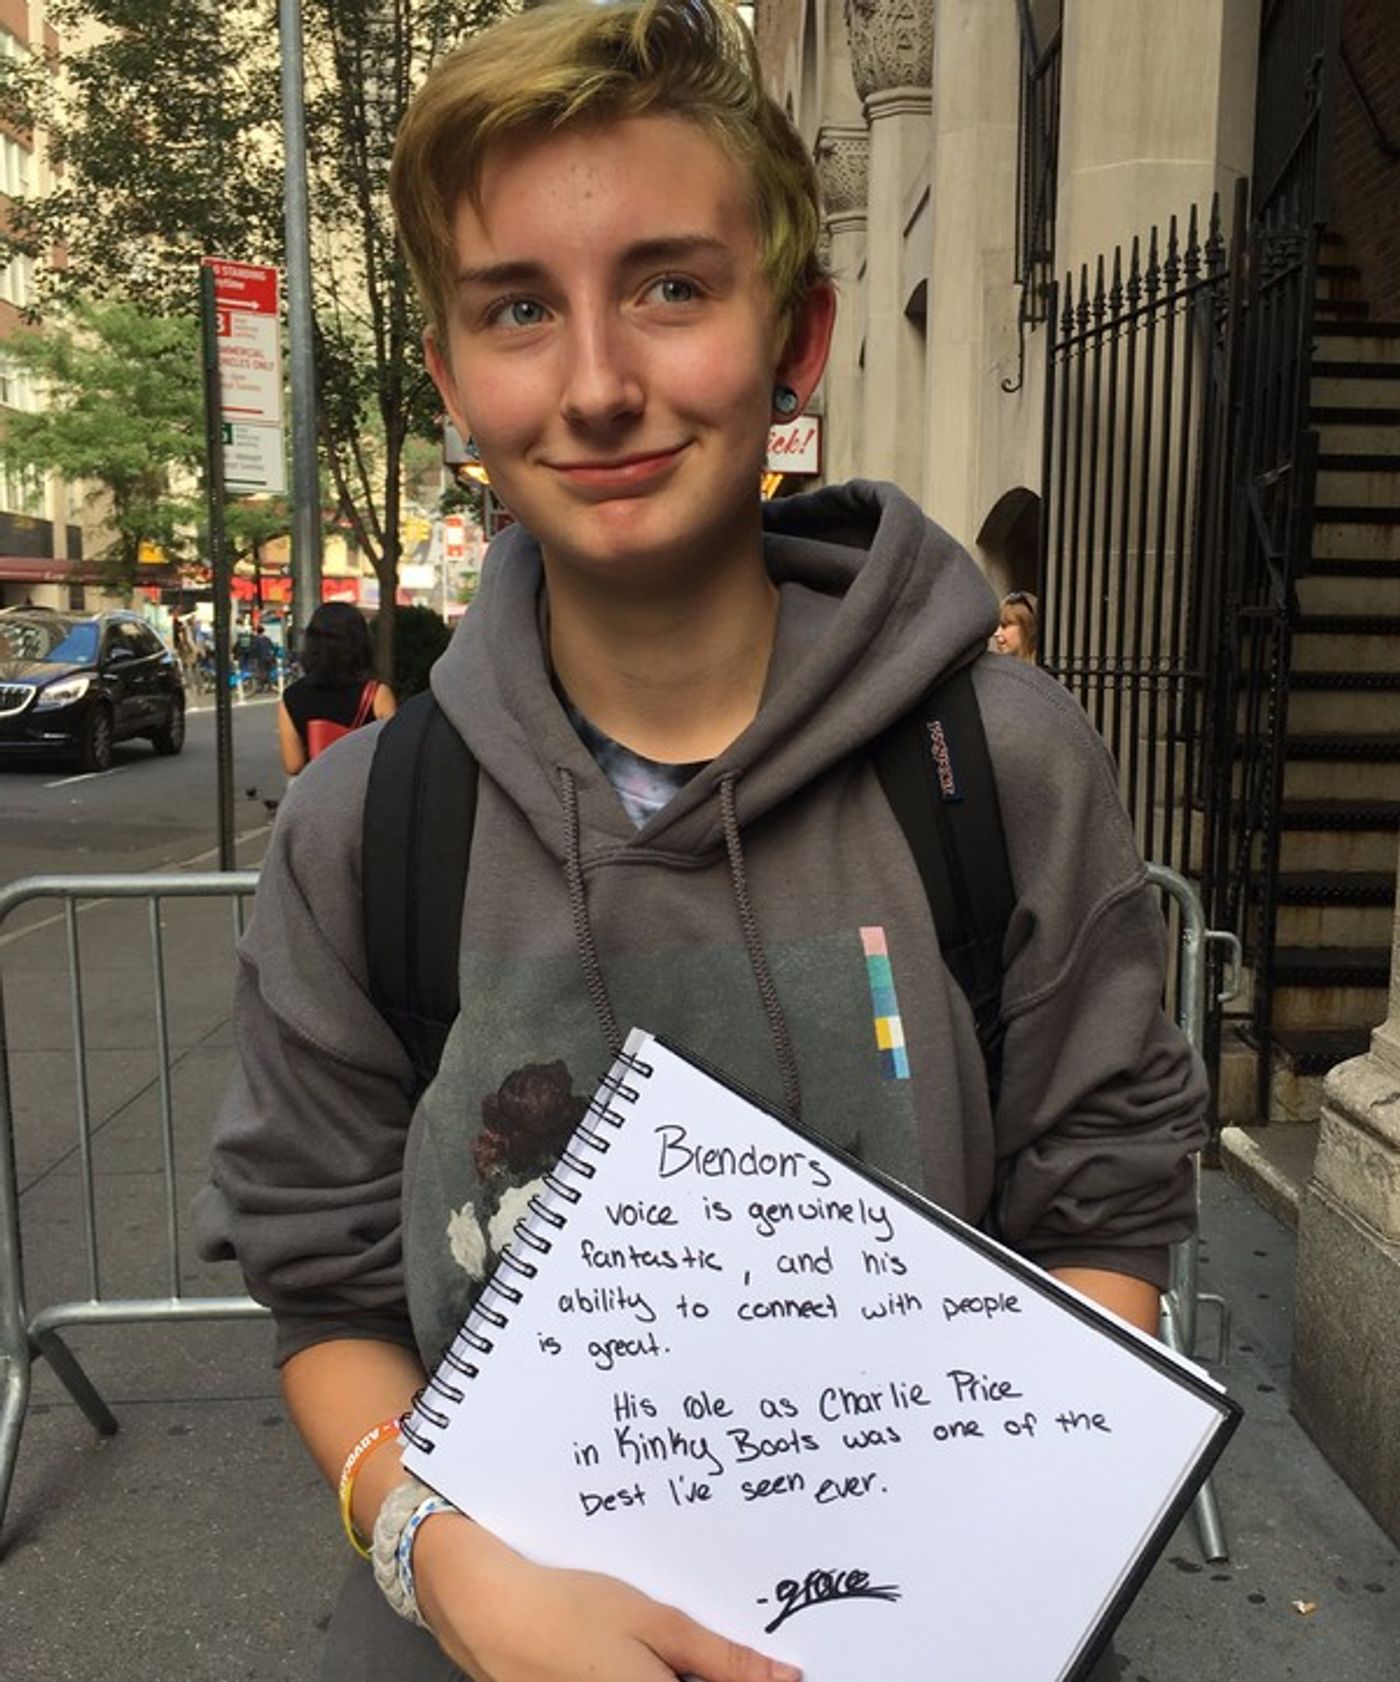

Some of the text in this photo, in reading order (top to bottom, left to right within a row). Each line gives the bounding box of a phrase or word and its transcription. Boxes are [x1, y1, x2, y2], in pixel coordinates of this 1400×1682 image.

[605, 1193, 899, 1243] voice is genuinely
[776, 1245, 834, 1276] and
[861, 1250, 908, 1276] his
[557, 1285, 1023, 1324] ability to connect with people
[536, 1331, 671, 1372] is great.
[613, 1369, 1024, 1423] His role as Charlie Price
[573, 1410, 1112, 1478] in Kinky Boots was one of the
[578, 1472, 888, 1517] best I've seen ever.
